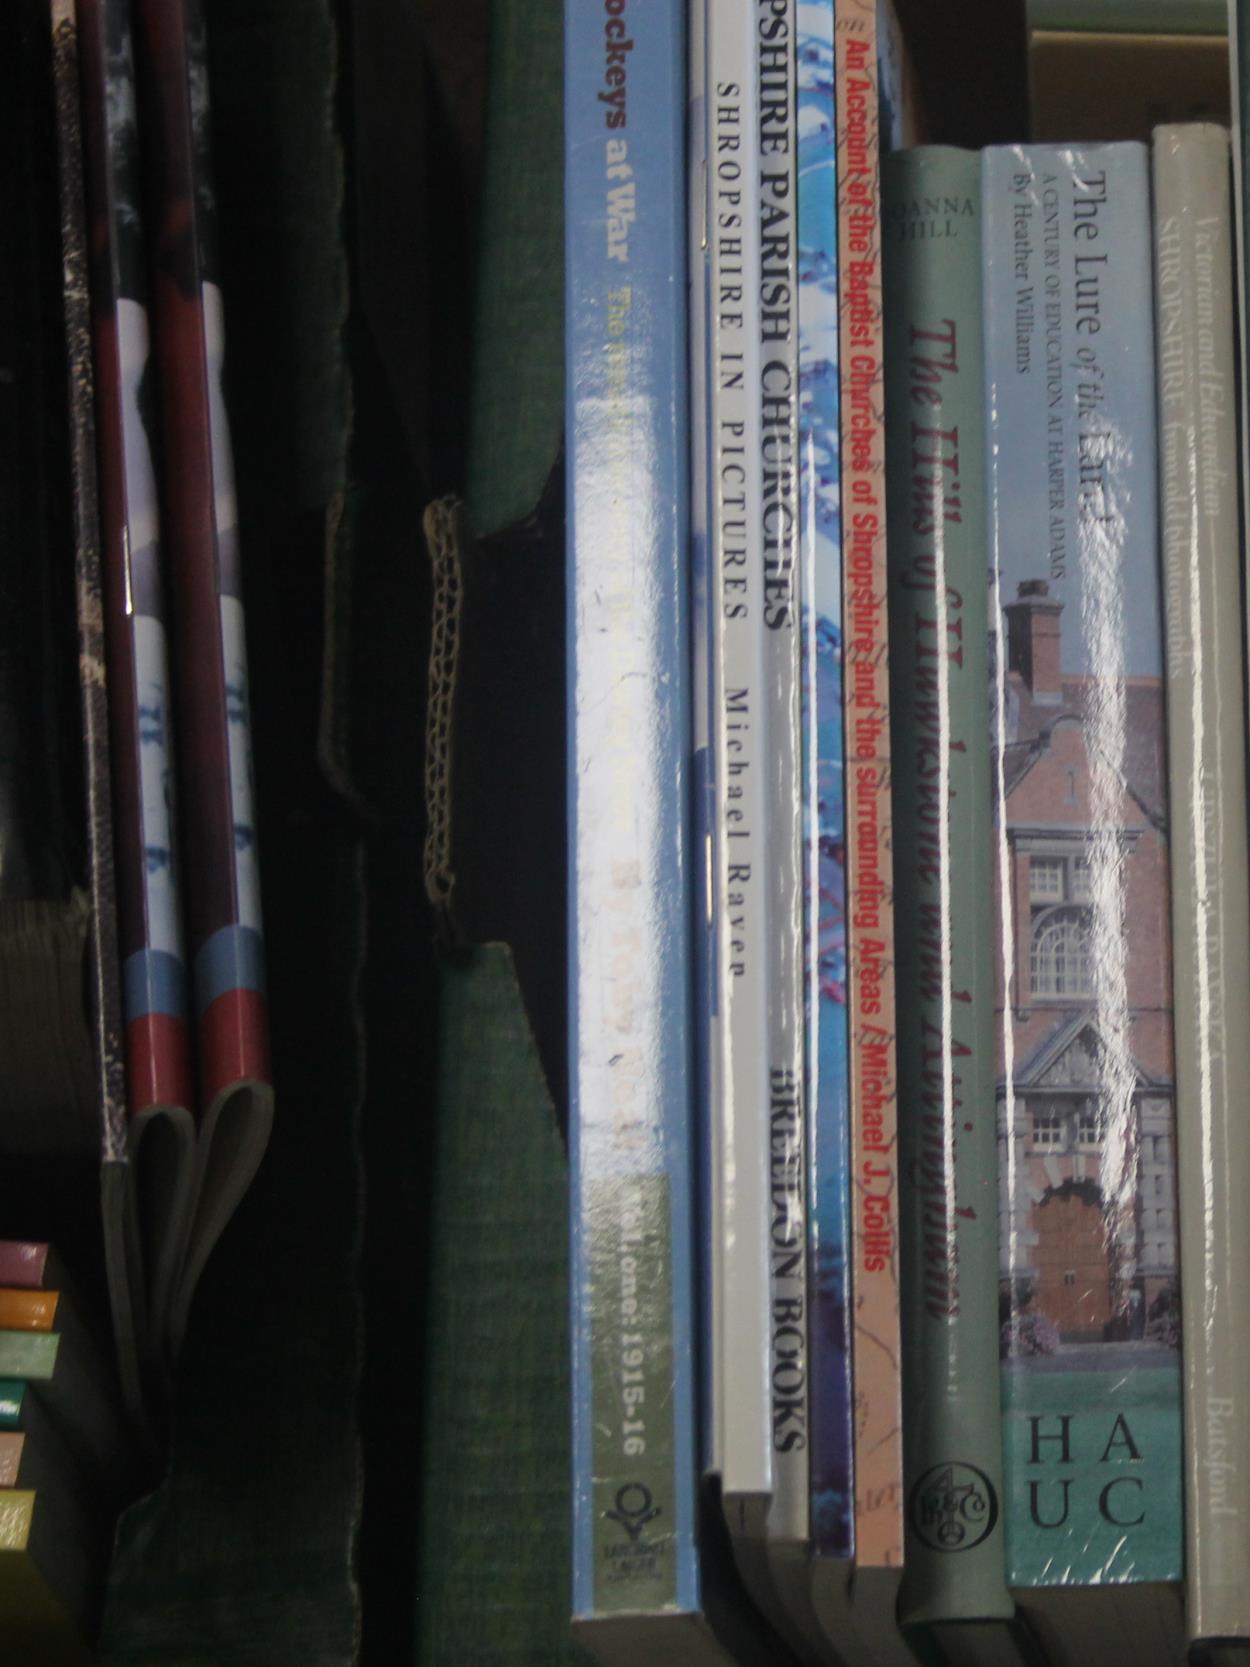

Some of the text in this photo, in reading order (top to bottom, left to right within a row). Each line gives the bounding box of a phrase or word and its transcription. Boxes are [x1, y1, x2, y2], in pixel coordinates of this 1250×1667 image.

[605, 139, 636, 180] at
[605, 181, 636, 262] War
[759, 170, 793, 345] PARISH
[1010, 173, 1037, 375] By Heather Williams
[1068, 170, 1110, 420] The Lure of the
[1160, 216, 1186, 408] SHROPSHIRE
[908, 319, 961, 408] The
[1042, 172, 1069, 581] A CENTURY OF EDUCATION AT HARPER ADAMS
[716, 82, 753, 978] SHROPSHIRE IN PICTURES Michael Raven
[760, 359, 795, 633] CHURCHES
[908, 420, 963, 537] Hills
[843, 39, 891, 1273] An Account of the Baptist Churches of Shropshire and the surrounding Areas Michael J. Collis
[620, 1332, 646, 1457] 1915-16
[771, 1297, 807, 1455] BOOKS
[1203, 1396, 1238, 1516] Batsford
